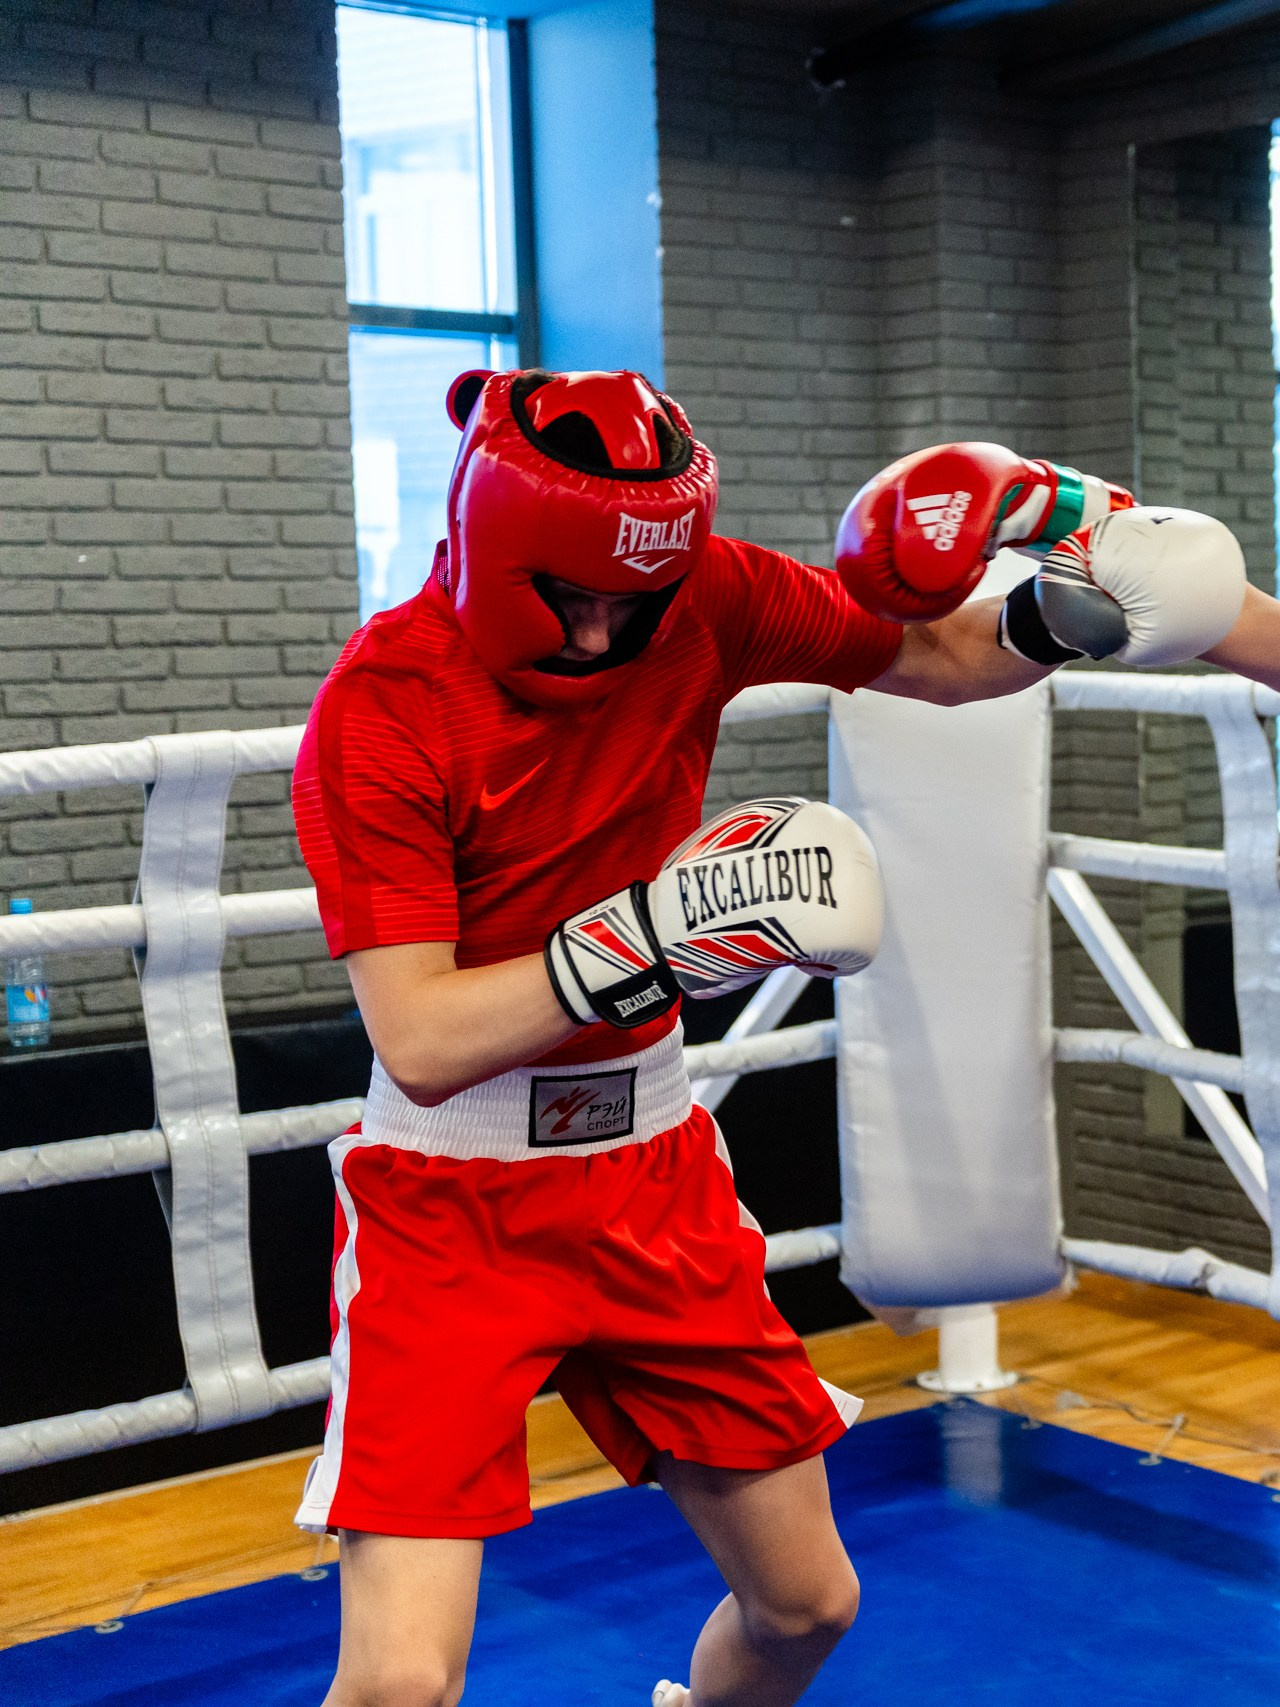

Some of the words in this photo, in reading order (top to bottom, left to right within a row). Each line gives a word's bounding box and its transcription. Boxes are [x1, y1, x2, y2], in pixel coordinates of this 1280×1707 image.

[612, 507, 696, 557] EVERLAST
[933, 490, 973, 551] adidas
[676, 846, 838, 932] EXCALIBUR
[613, 984, 668, 1018] EXCALIBUR
[587, 1096, 627, 1121] РЭЙ
[587, 1116, 626, 1131] СПОРТ
